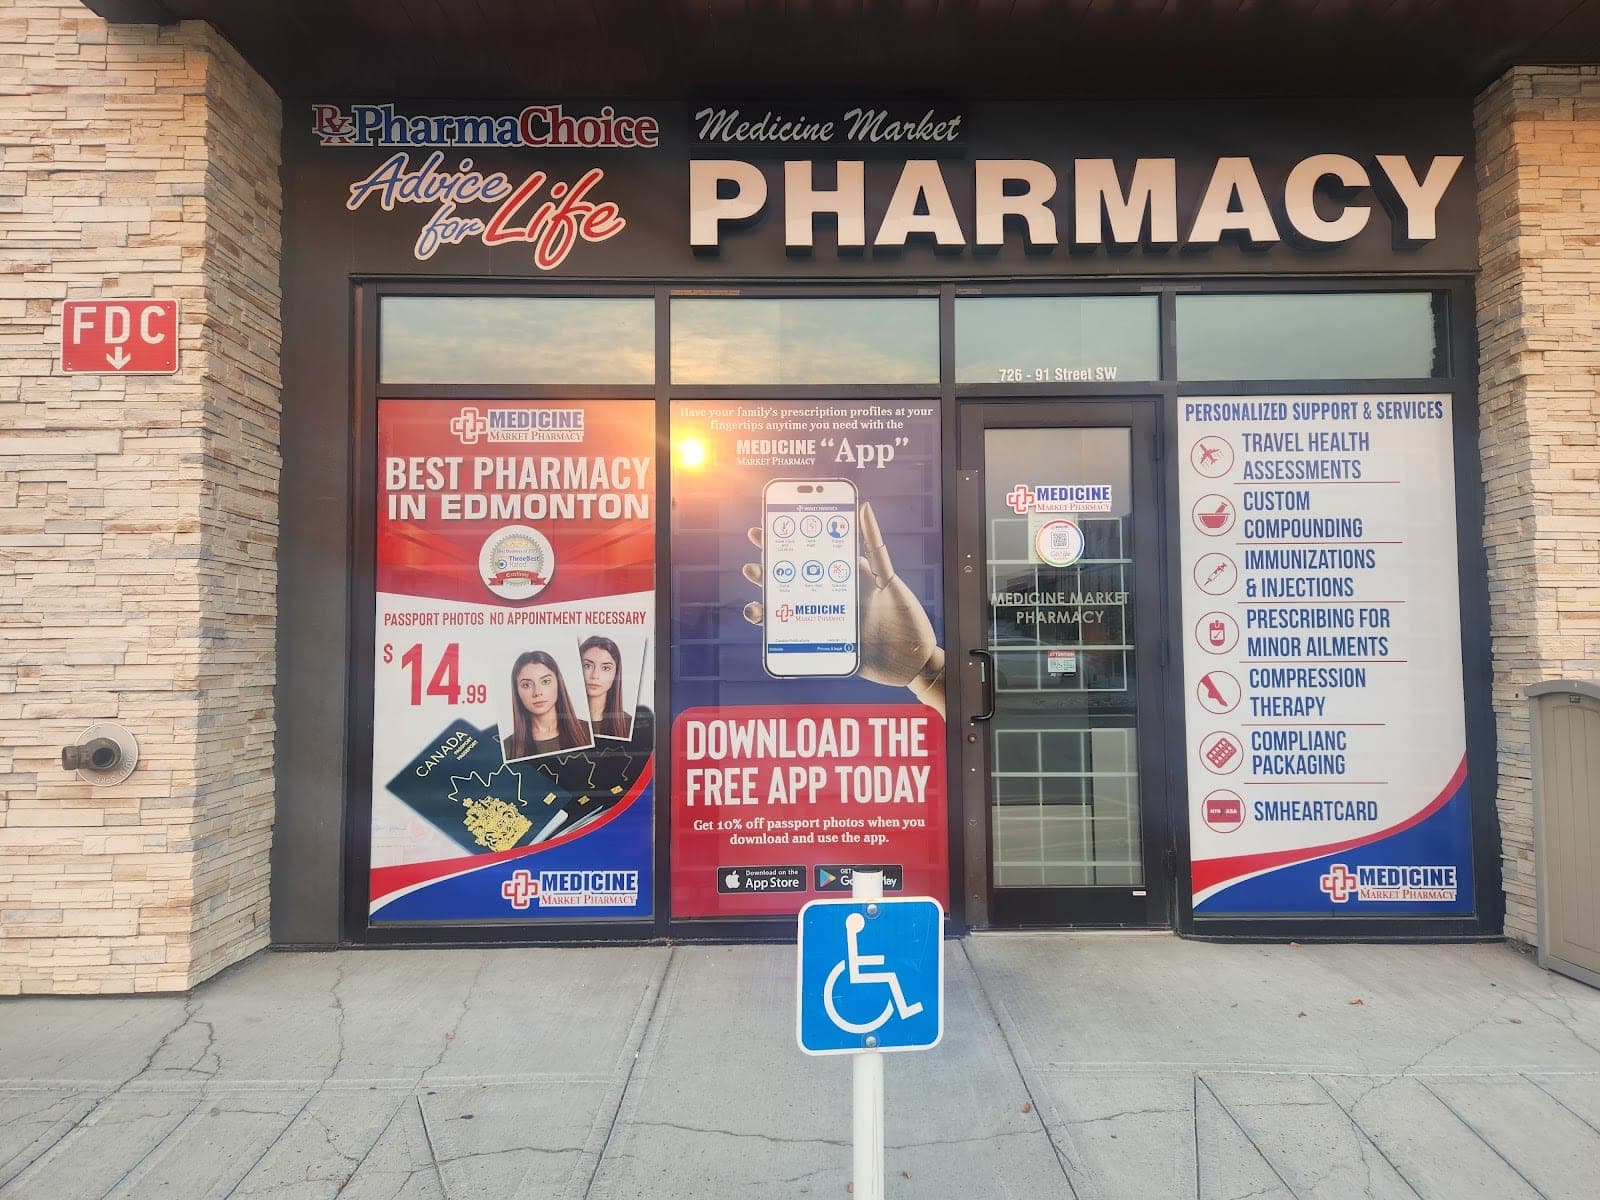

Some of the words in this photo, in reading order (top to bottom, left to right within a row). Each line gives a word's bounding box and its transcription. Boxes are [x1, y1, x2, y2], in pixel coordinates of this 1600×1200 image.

[353, 104, 660, 147] PharmaChoice
[695, 107, 834, 143] Medicine
[843, 108, 962, 143] Market
[347, 151, 512, 211] Advice
[689, 153, 1465, 247] PHARMACY
[415, 202, 485, 260] for
[481, 167, 626, 270] Life
[73, 306, 166, 345] FDC
[999, 368, 1022, 381] 726
[1035, 367, 1049, 381] 91
[1054, 367, 1092, 380] Street
[1096, 366, 1117, 380] SW
[489, 410, 583, 429] MEDICINE
[680, 408, 706, 417] Have
[707, 409, 735, 419] your
[780, 406, 847, 418] prescription
[850, 406, 892, 418] profiles
[895, 407, 905, 416] at
[907, 408, 933, 418] your
[1185, 403, 1287, 421] PERSONALIZED
[1293, 402, 1358, 420] SUPPORT
[1363, 402, 1372, 420] &
[1376, 401, 1443, 420] SERVICES
[710, 420, 763, 431] fingertips
[766, 420, 807, 431] anytime
[810, 422, 830, 431] you
[832, 420, 858, 430] need
[860, 420, 884, 430] with
[886, 420, 904, 429] the
[490, 431, 528, 441] MARKET
[531, 431, 583, 441] PHARMACY
[1242, 432, 1306, 453] TRAVEL
[1308, 432, 1370, 452] HEALTH
[736, 440, 816, 455] MEDICINE
[772, 457, 816, 465] PHARMACY
[1243, 460, 1362, 480] ASSESSMENTS
[386, 457, 463, 490] BEST
[474, 456, 650, 490] PHARMACY
[1037, 486, 1110, 501] MEDICINE
[1243, 491, 1310, 511] CUSTOM
[388, 494, 426, 520] IN
[441, 494, 649, 520] EDMONTON
[1037, 503, 1068, 511] MARKET
[1070, 503, 1111, 511] PHARMACY
[1244, 518, 1363, 539] COMPOUNDING
[1245, 549, 1376, 570] IMMUNIZATIONS
[1246, 578, 1257, 597] &
[1262, 578, 1354, 597] INJECTIONS
[991, 592, 1065, 605] MEDICINE
[1070, 592, 1129, 604] MARKET
[384, 613, 439, 626] PASSPORT
[442, 612, 484, 626] PHOTOS
[490, 612, 504, 625] NO
[507, 611, 582, 625] APPOINTMENT
[585, 611, 646, 625] NECESSARY
[795, 604, 846, 615] MEDICINE
[1016, 610, 1104, 624] PHARMACY
[1247, 608, 1354, 629] PRESCRIBING
[1359, 608, 1391, 628] FOR
[1248, 637, 1302, 657] MINOR
[1306, 636, 1389, 656] AILMENTS
[1249, 668, 1366, 688] COMPRESSION
[1250, 696, 1326, 717] THERAPY
[687, 718, 859, 760] DOWNLOAD
[868, 717, 929, 757] THE
[1251, 730, 1347, 750] COMPLIANC
[416, 731, 468, 777] CANADA
[1253, 754, 1346, 775] PACKAGING
[687, 767, 758, 806] FREE
[767, 766, 827, 805] APP
[835, 765, 931, 803] TODAY
[1254, 800, 1378, 822] SMHEARTCARD
[694, 819, 713, 831] Get
[717, 818, 742, 830] 10%
[746, 817, 764, 829] off
[767, 817, 820, 831] passport
[823, 817, 864, 830] photos
[868, 817, 900, 827] when
[902, 818, 926, 830] you
[730, 832, 789, 845] download
[792, 832, 815, 844] and
[817, 834, 839, 843] use
[841, 832, 860, 843] the
[863, 834, 890, 845] app.
[542, 872, 636, 891] MEDICINE
[745, 877, 768, 890] App
[770, 877, 800, 888] Store
[1360, 868, 1455, 886] MEDICINE
[541, 895, 581, 905] MARKET
[584, 895, 636, 905] PHARMACY
[1360, 889, 1400, 899] MARKET
[1402, 889, 1455, 899] PHARMACY
